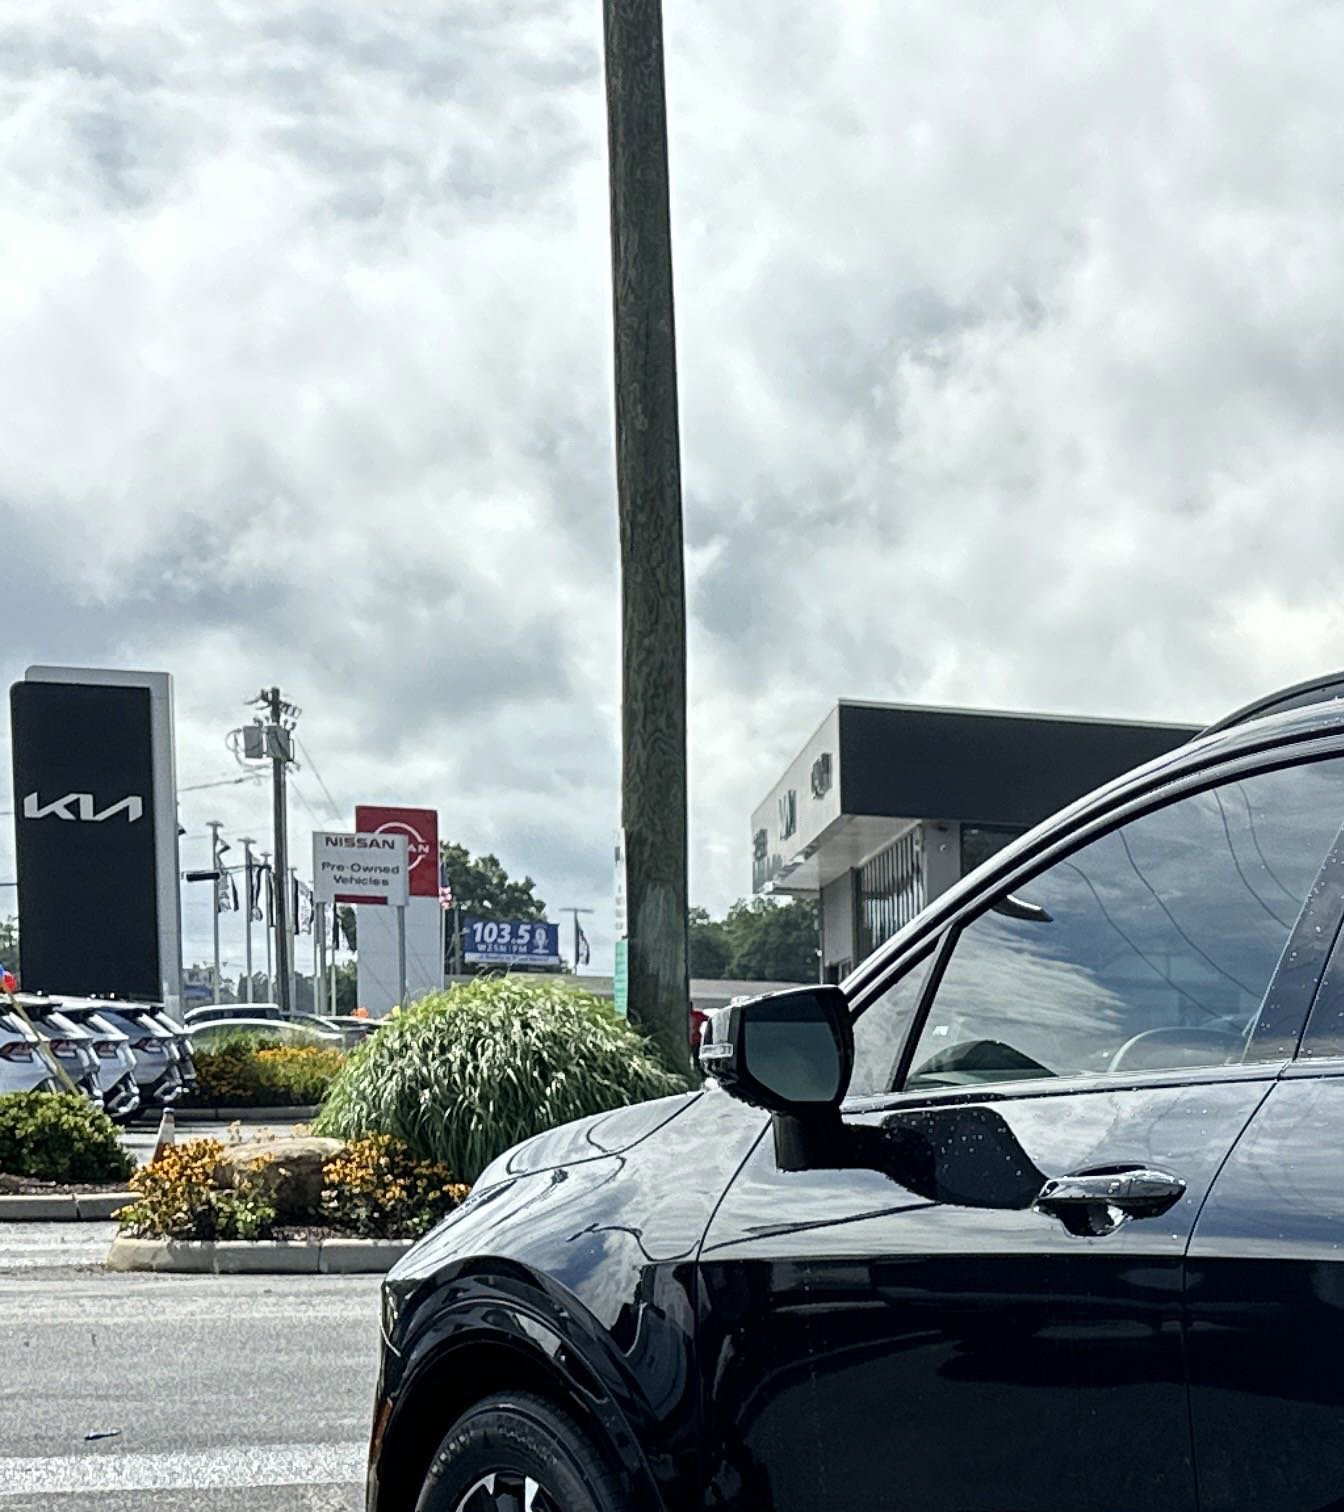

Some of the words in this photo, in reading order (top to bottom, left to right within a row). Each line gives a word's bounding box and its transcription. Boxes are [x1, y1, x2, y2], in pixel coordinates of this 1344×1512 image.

[23, 791, 143, 823] KIA
[325, 836, 395, 850] NISSAN
[321, 861, 400, 875] Pre-Owned
[333, 874, 389, 887] Vehicles
[473, 921, 532, 945] 103.5
